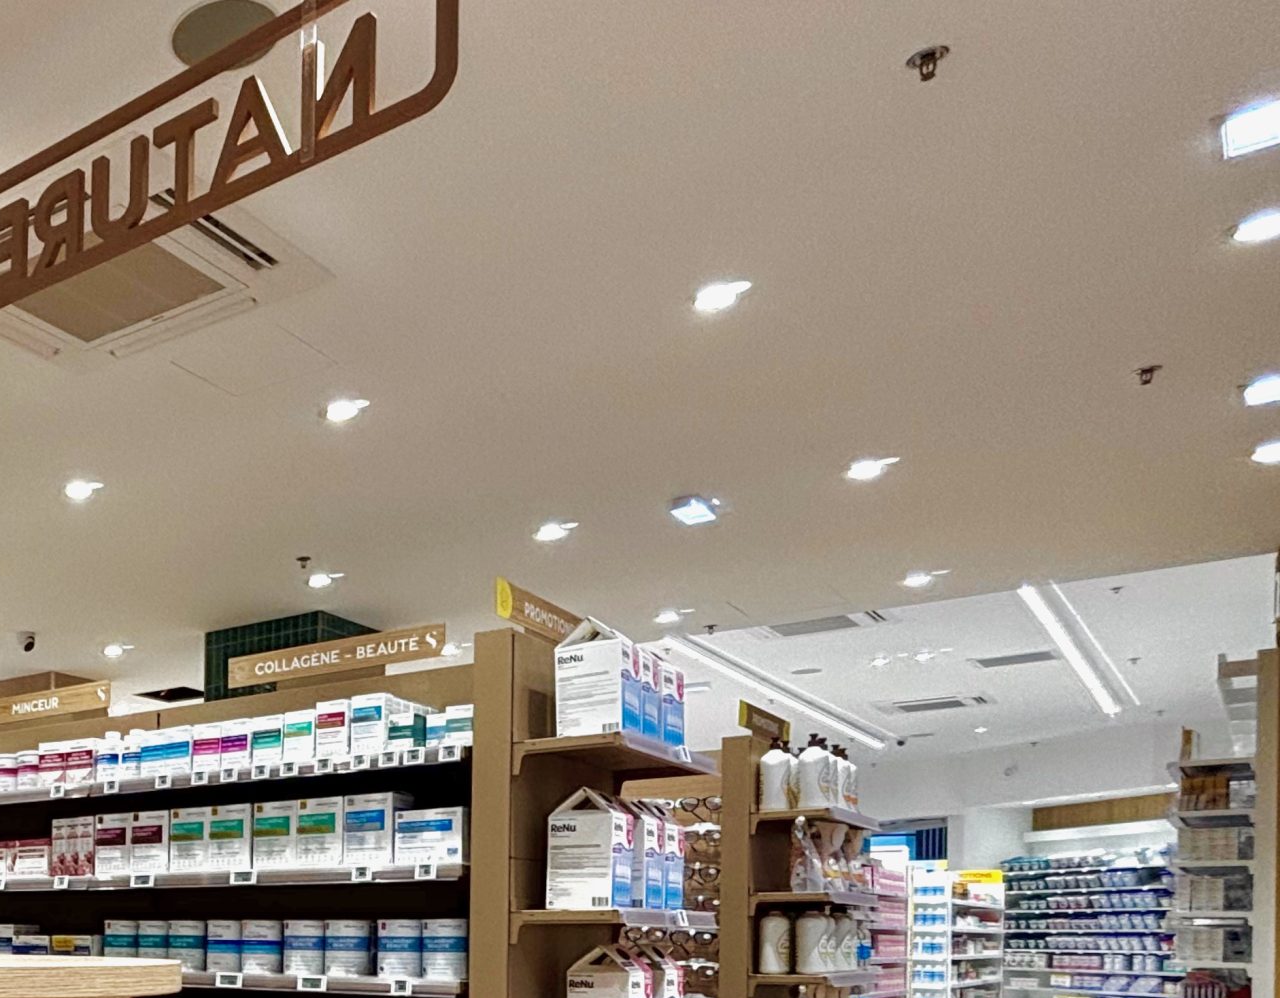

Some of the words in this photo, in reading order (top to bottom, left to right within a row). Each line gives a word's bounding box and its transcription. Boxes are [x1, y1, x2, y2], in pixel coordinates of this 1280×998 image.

[356, 635, 419, 659] BEAUTÉ
[557, 654, 584, 666] ReNu
[12, 697, 59, 715] MINCEUR
[550, 823, 577, 833] ReNu
[568, 979, 595, 989] ReNu
